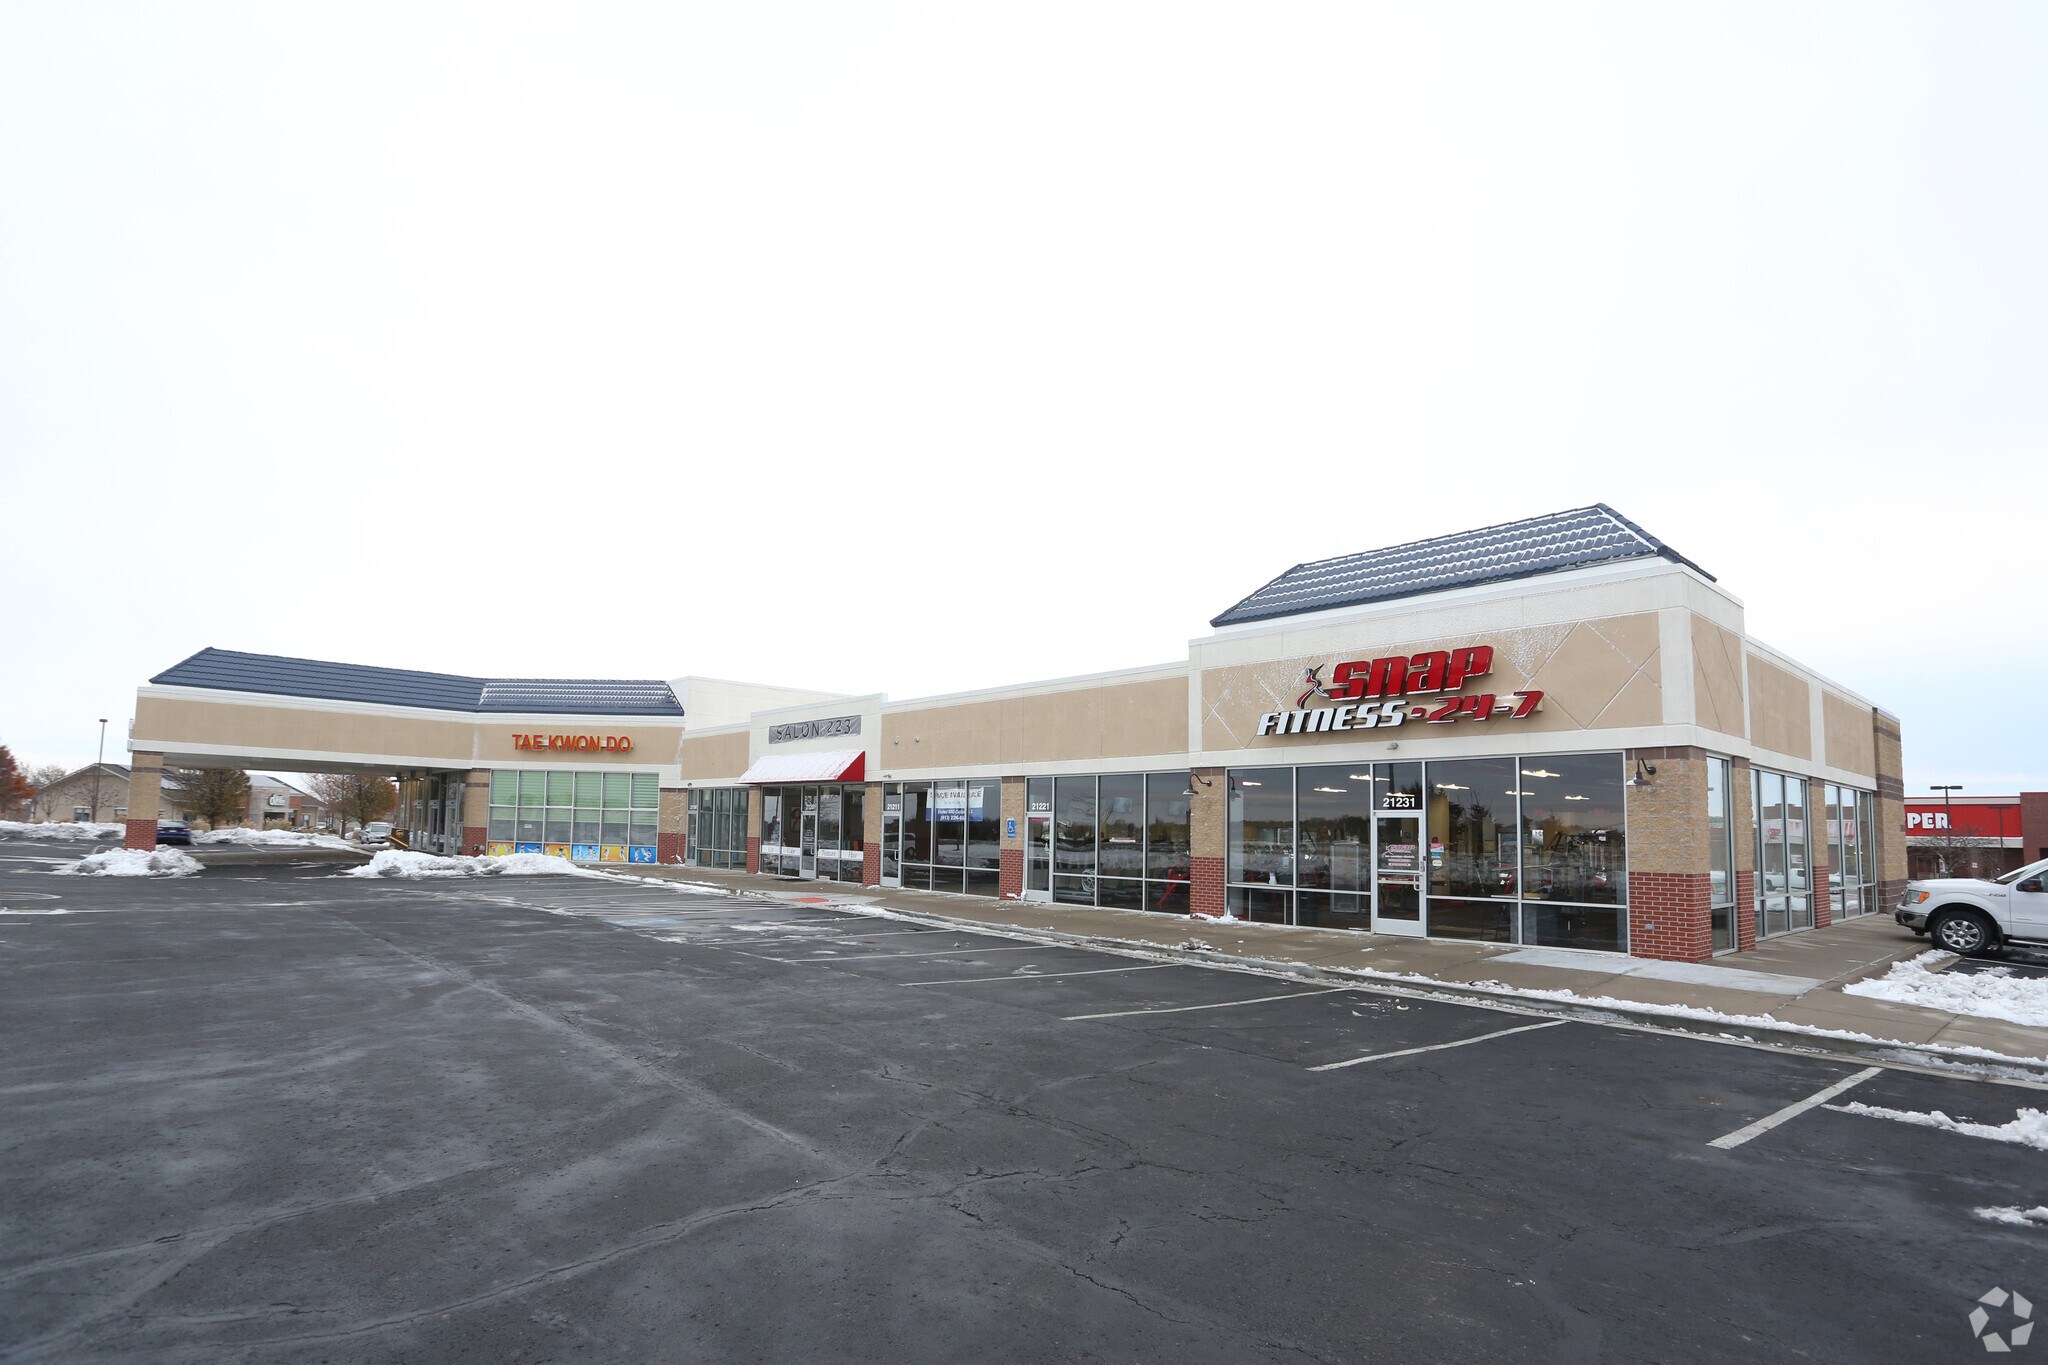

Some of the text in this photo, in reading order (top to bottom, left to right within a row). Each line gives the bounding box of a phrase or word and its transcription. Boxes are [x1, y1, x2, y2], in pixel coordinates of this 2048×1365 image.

[1256, 700, 1407, 736] FITNESS
[776, 718, 852, 741] SALON 223
[512, 733, 632, 753] TAE KWON DO
[1031, 802, 1050, 810] 21221
[1382, 797, 1416, 808] 21231
